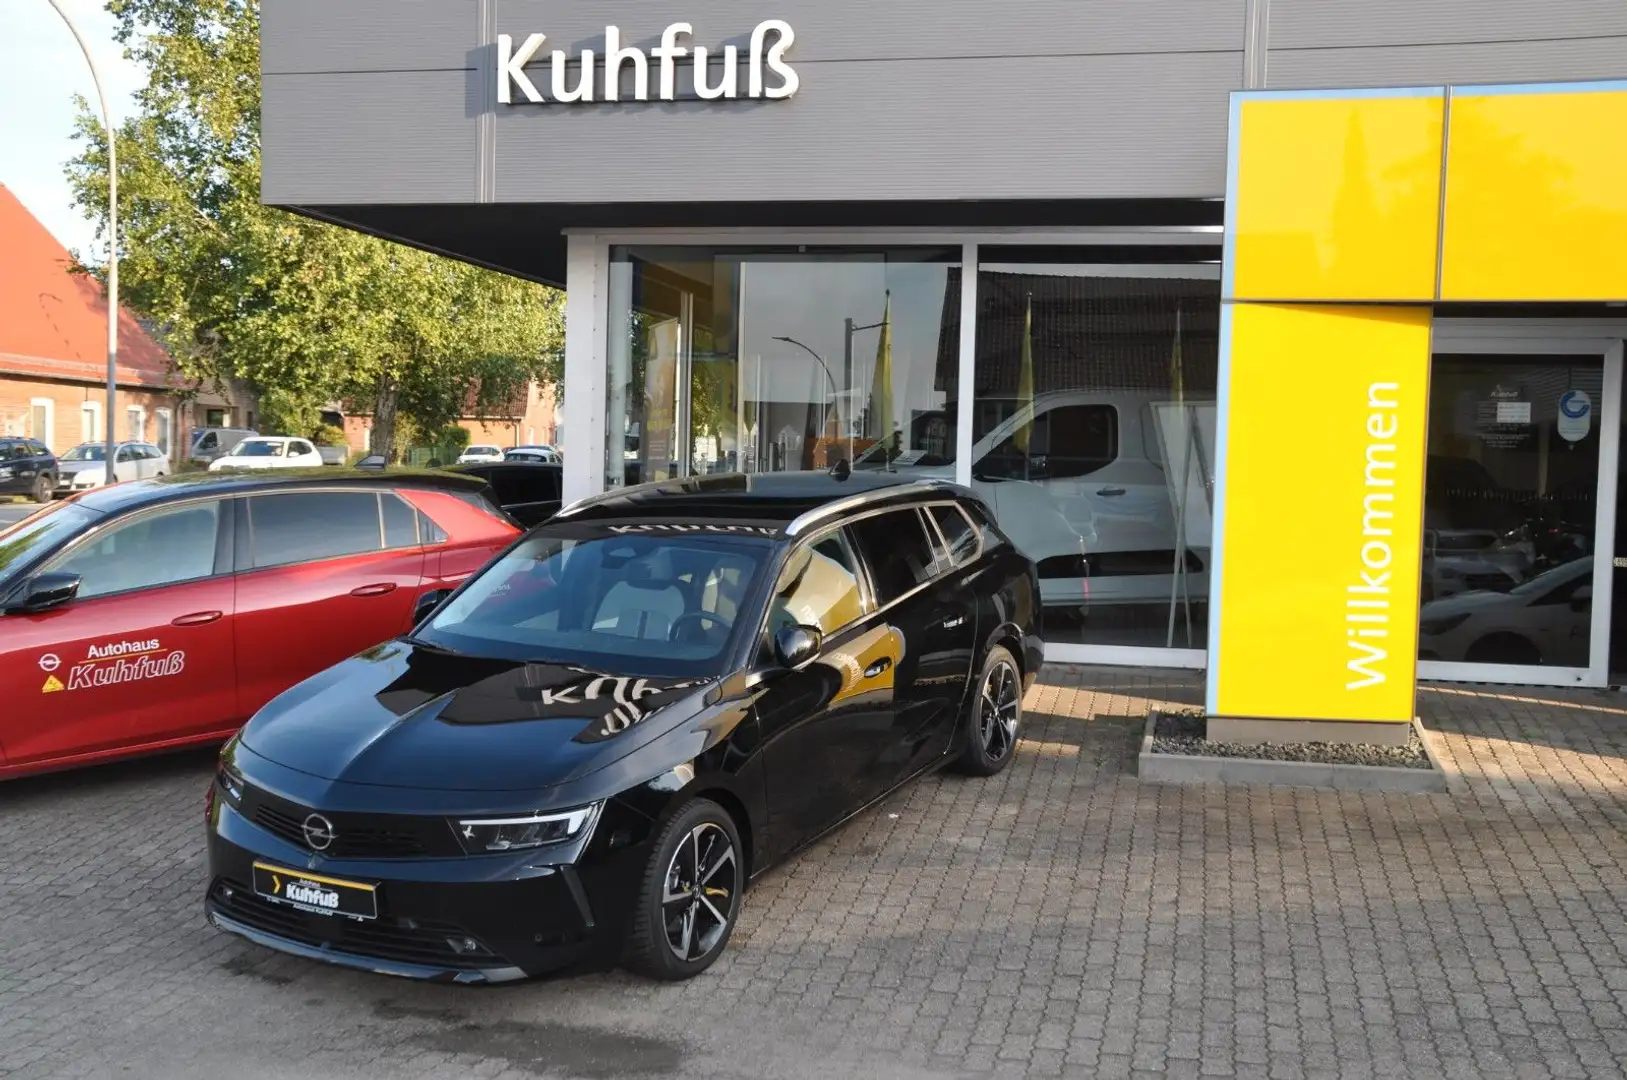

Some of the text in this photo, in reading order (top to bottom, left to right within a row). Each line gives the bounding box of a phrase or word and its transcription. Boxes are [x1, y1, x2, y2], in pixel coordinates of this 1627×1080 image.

[497, 19, 799, 104] Kuhfuß
[1345, 381, 1400, 690] Willkommen
[87, 638, 160, 659] Autohaus
[67, 650, 185, 690] Kuhfuß
[286, 883, 339, 908] Kuhfuß
